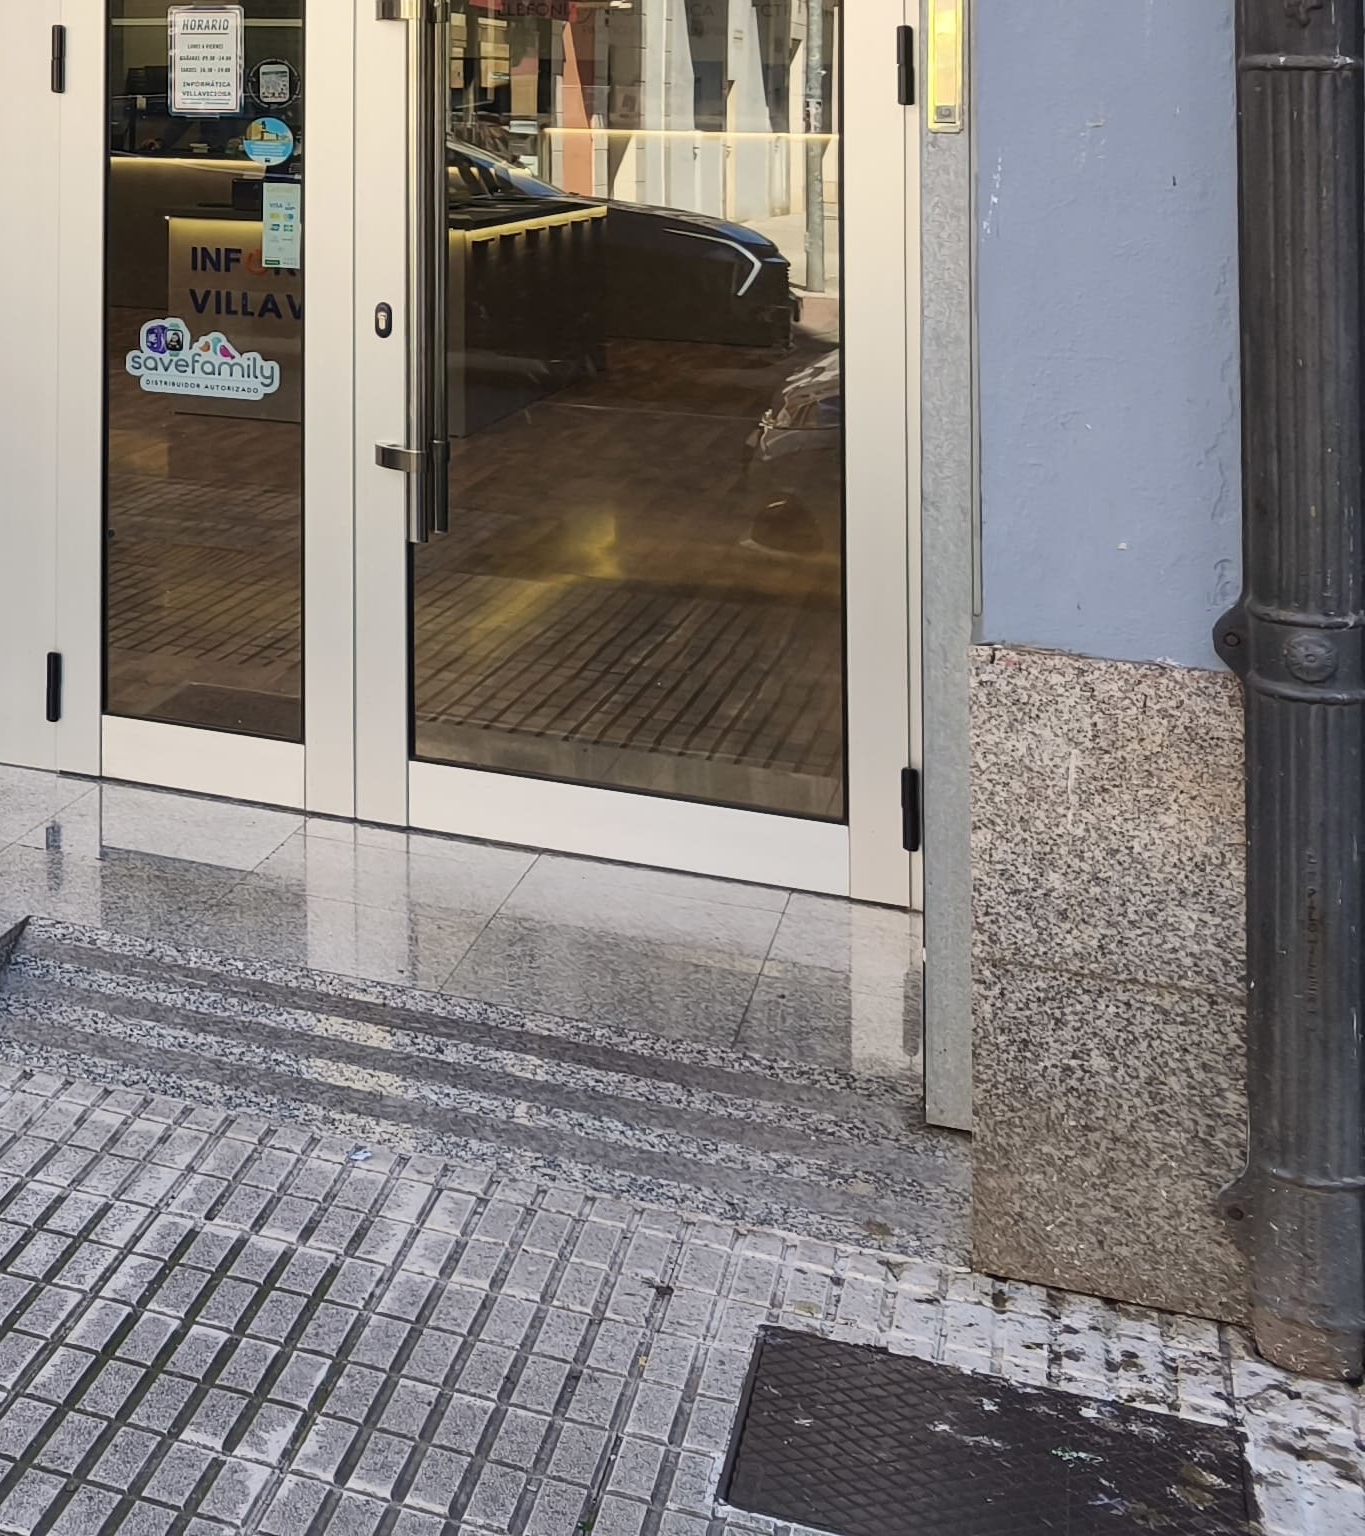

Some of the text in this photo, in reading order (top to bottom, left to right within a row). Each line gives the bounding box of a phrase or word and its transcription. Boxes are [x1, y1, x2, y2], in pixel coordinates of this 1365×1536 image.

[181, 19, 230, 32] HORARIO
[130, 352, 275, 388] savefamily
[145, 378, 259, 395] DISTRIBUIDOR AUTORIZADO
